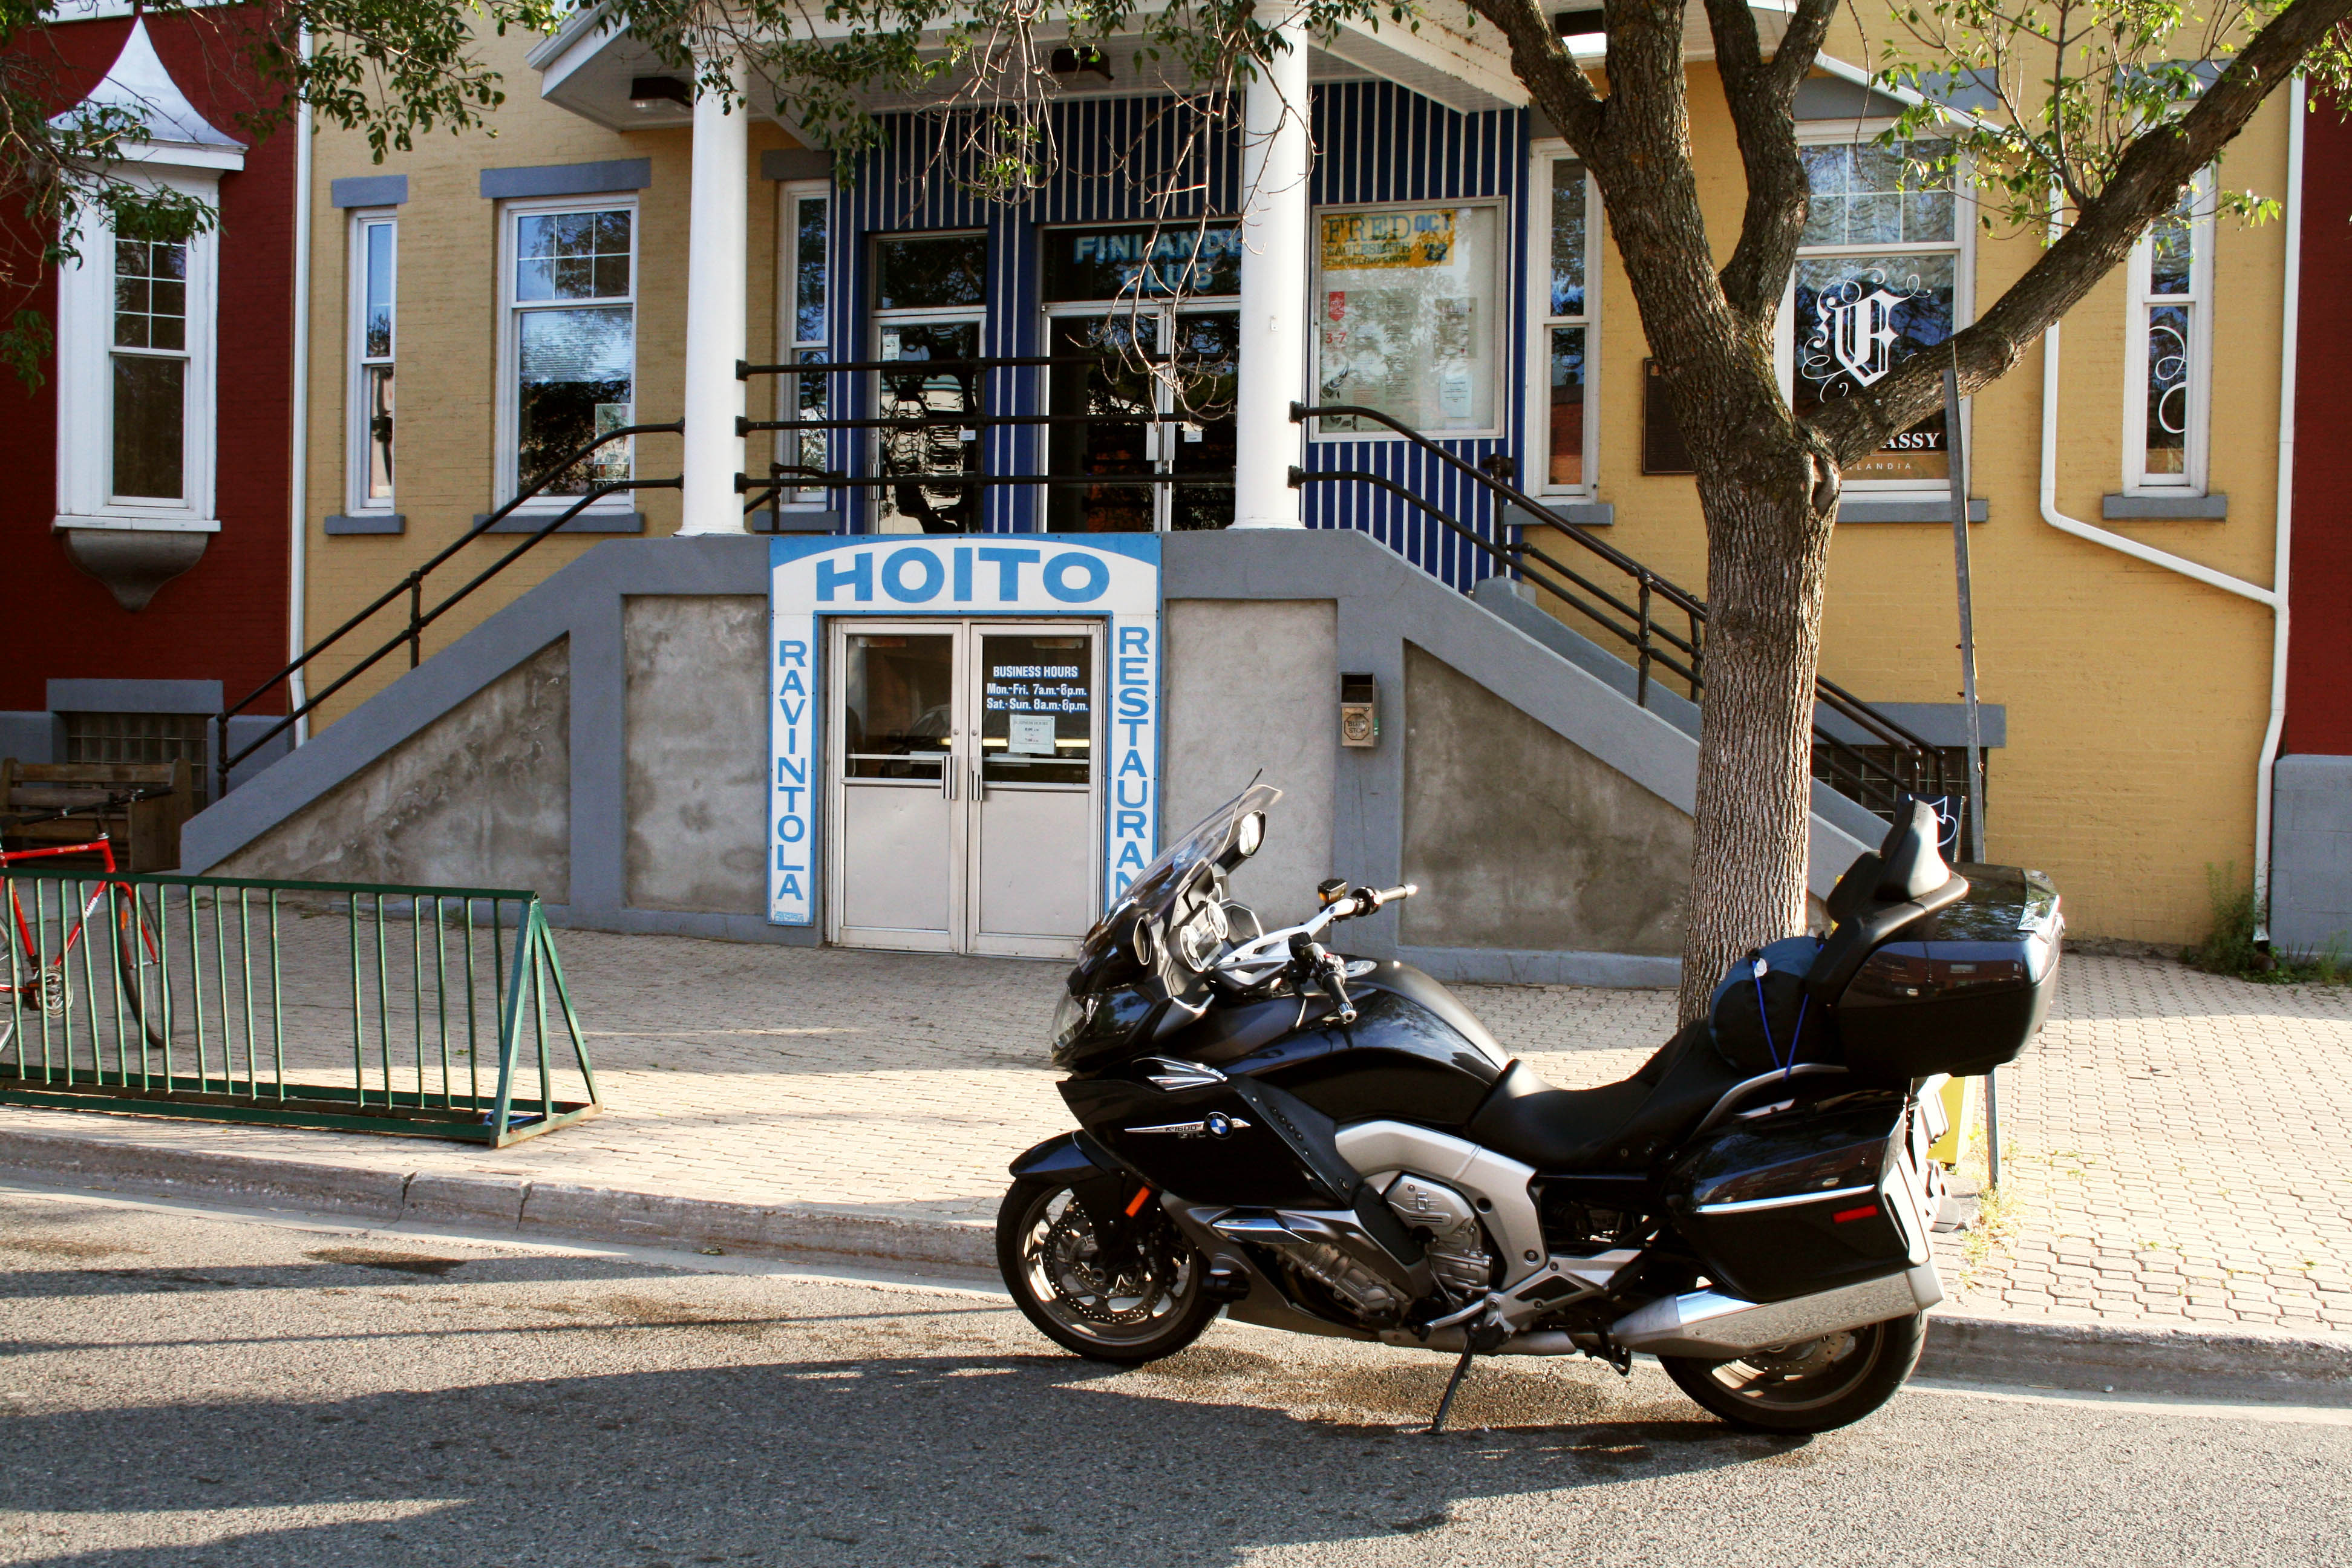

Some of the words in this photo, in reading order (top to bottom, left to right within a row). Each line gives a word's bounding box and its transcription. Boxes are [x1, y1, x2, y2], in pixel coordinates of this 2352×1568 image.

[1326, 215, 1411, 243] FRED
[1414, 214, 1451, 231] OCT
[1074, 229, 1241, 264] FINLANDI
[1122, 262, 1214, 292] CLUB
[1881, 433, 1940, 449] ASSY
[817, 547, 1110, 603] HOITO
[993, 666, 1042, 678] BUSINESS
[1044, 666, 1079, 678] HOURS
[777, 640, 807, 901] RAVINTOLA
[1114, 627, 1150, 899] RESTAURAN
